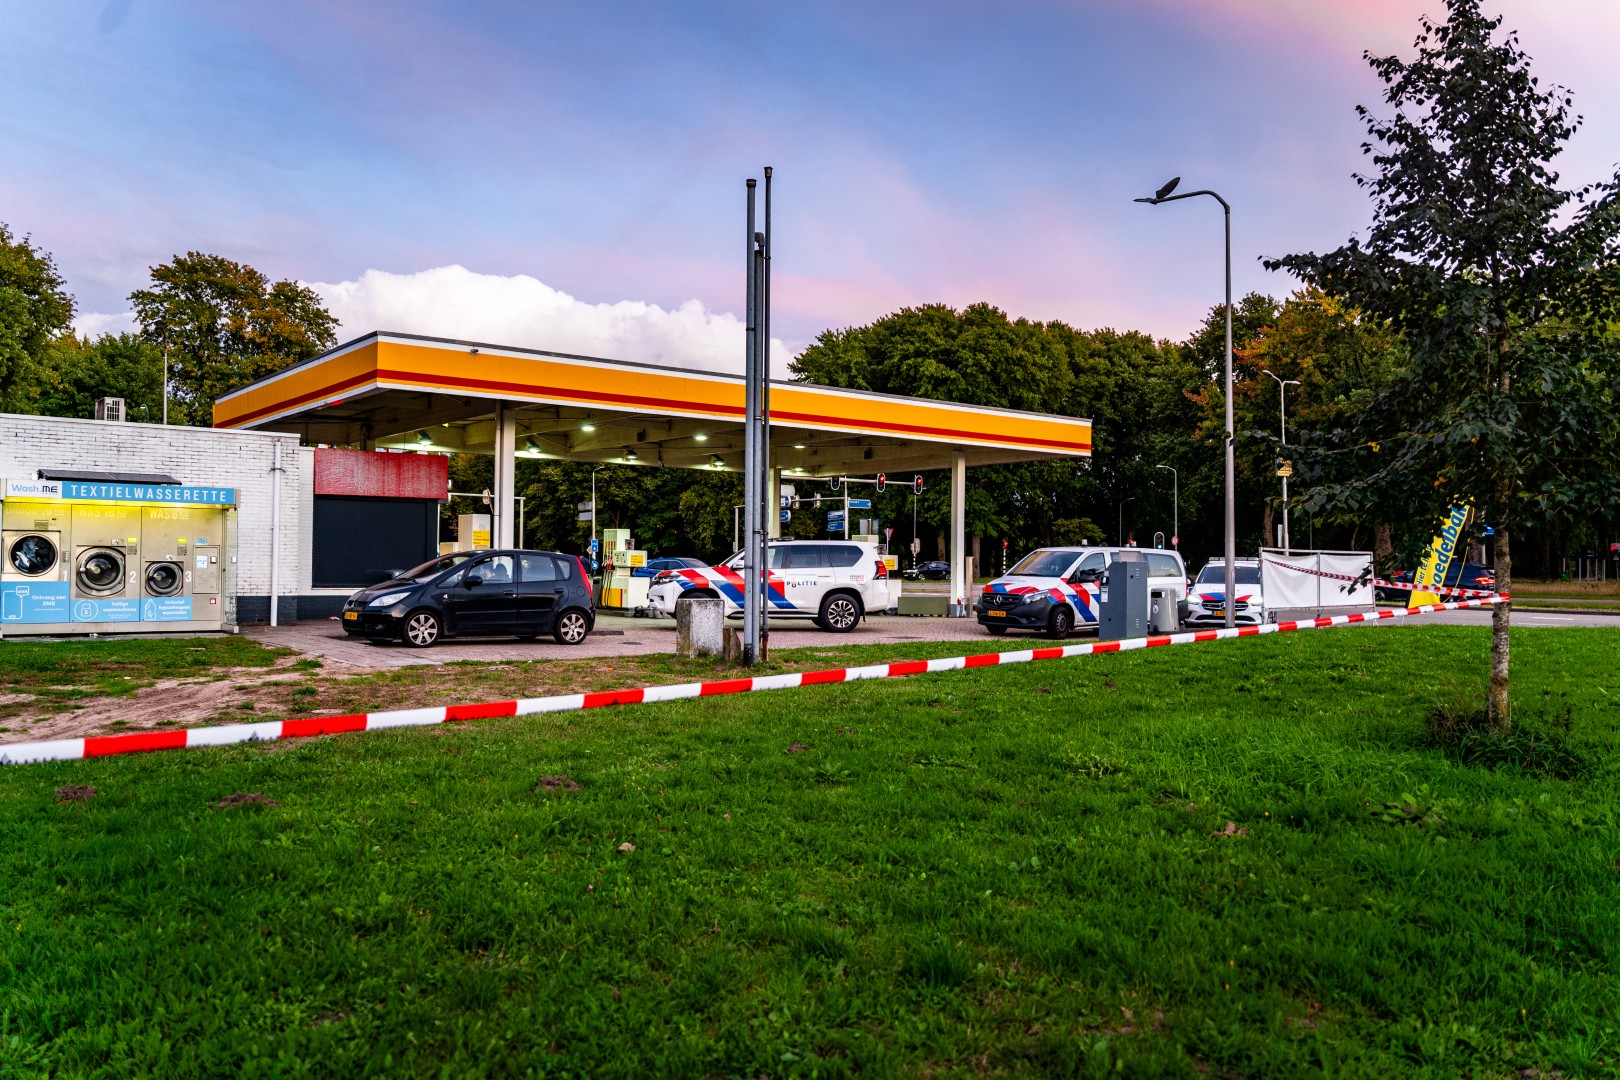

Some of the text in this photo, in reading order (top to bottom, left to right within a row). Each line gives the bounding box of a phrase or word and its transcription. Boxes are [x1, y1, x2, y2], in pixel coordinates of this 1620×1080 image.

[70, 484, 226, 502] TEXTIELWASSERETTE
[149, 509, 169, 519] WAS
[171, 510, 178, 520] 8
[1430, 504, 1467, 597] oedelbak
[62, 569, 68, 582] 1
[129, 570, 137, 583] 2
[185, 570, 192, 583] 3
[786, 580, 817, 588] POLITIE
